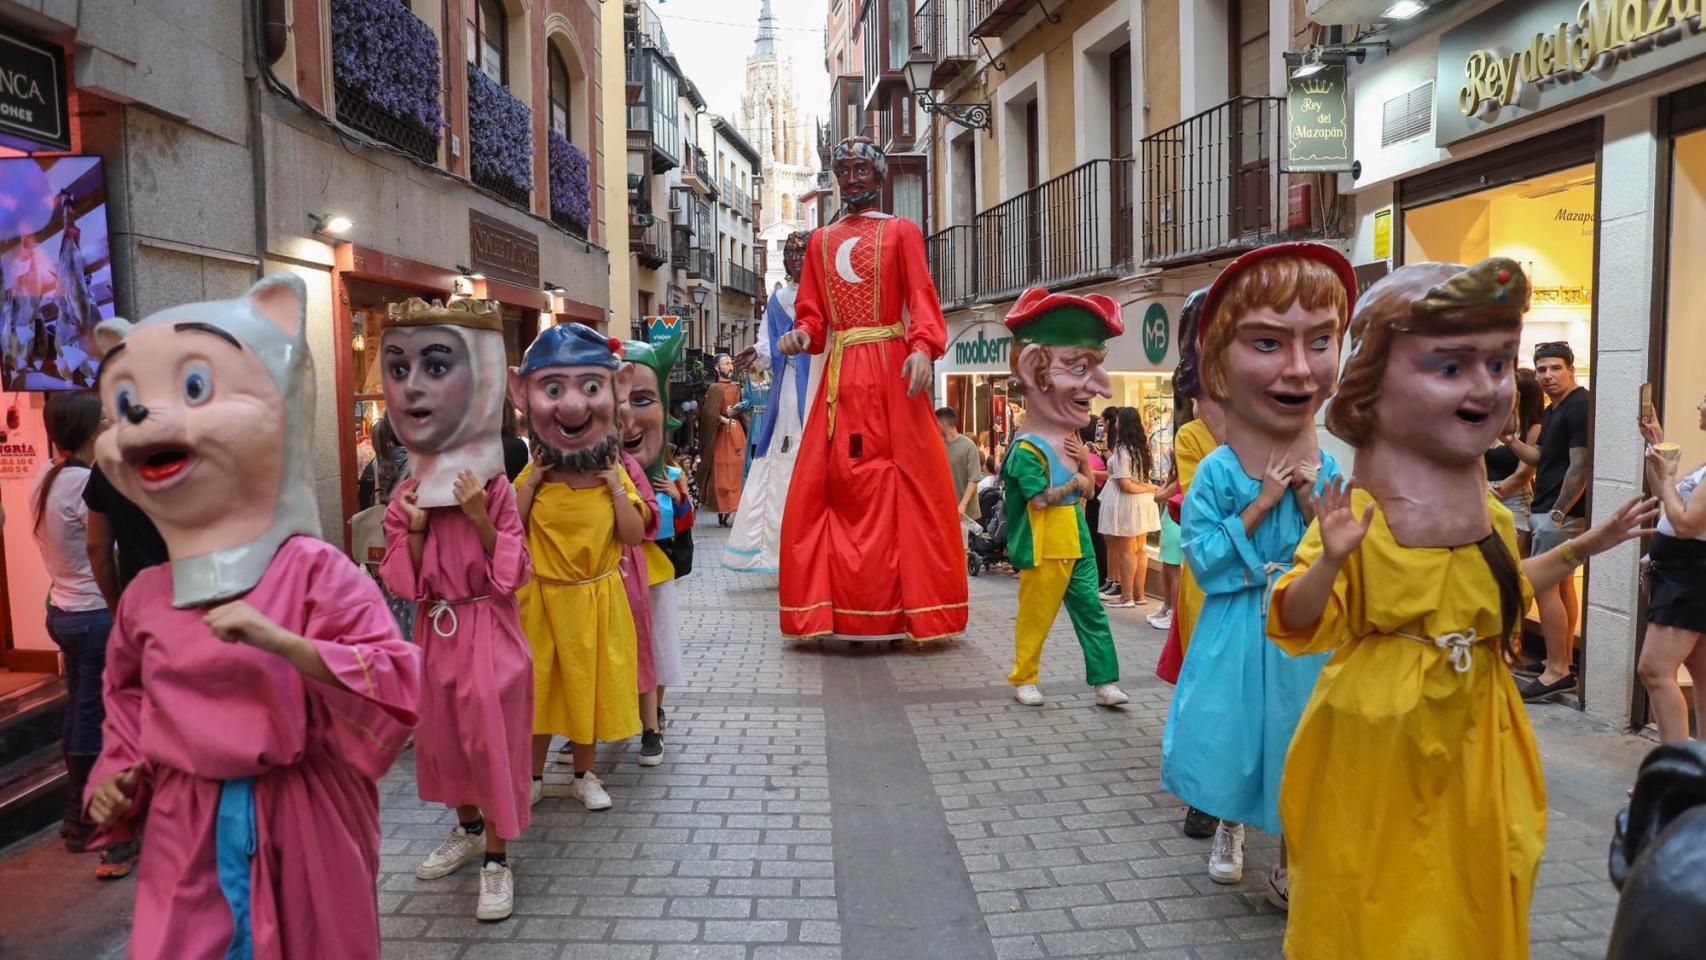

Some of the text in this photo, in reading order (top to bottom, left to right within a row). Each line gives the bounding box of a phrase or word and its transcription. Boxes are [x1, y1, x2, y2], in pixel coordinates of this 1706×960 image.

[1458, 50, 1520, 116] Rey
[1520, 22, 1568, 83] del
[1301, 98, 1322, 112] Rey
[1317, 113, 1331, 124] del
[1293, 125, 1343, 140] Mazapán
[1146, 318, 1165, 349] MB
[956, 331, 1011, 365] moolberr
